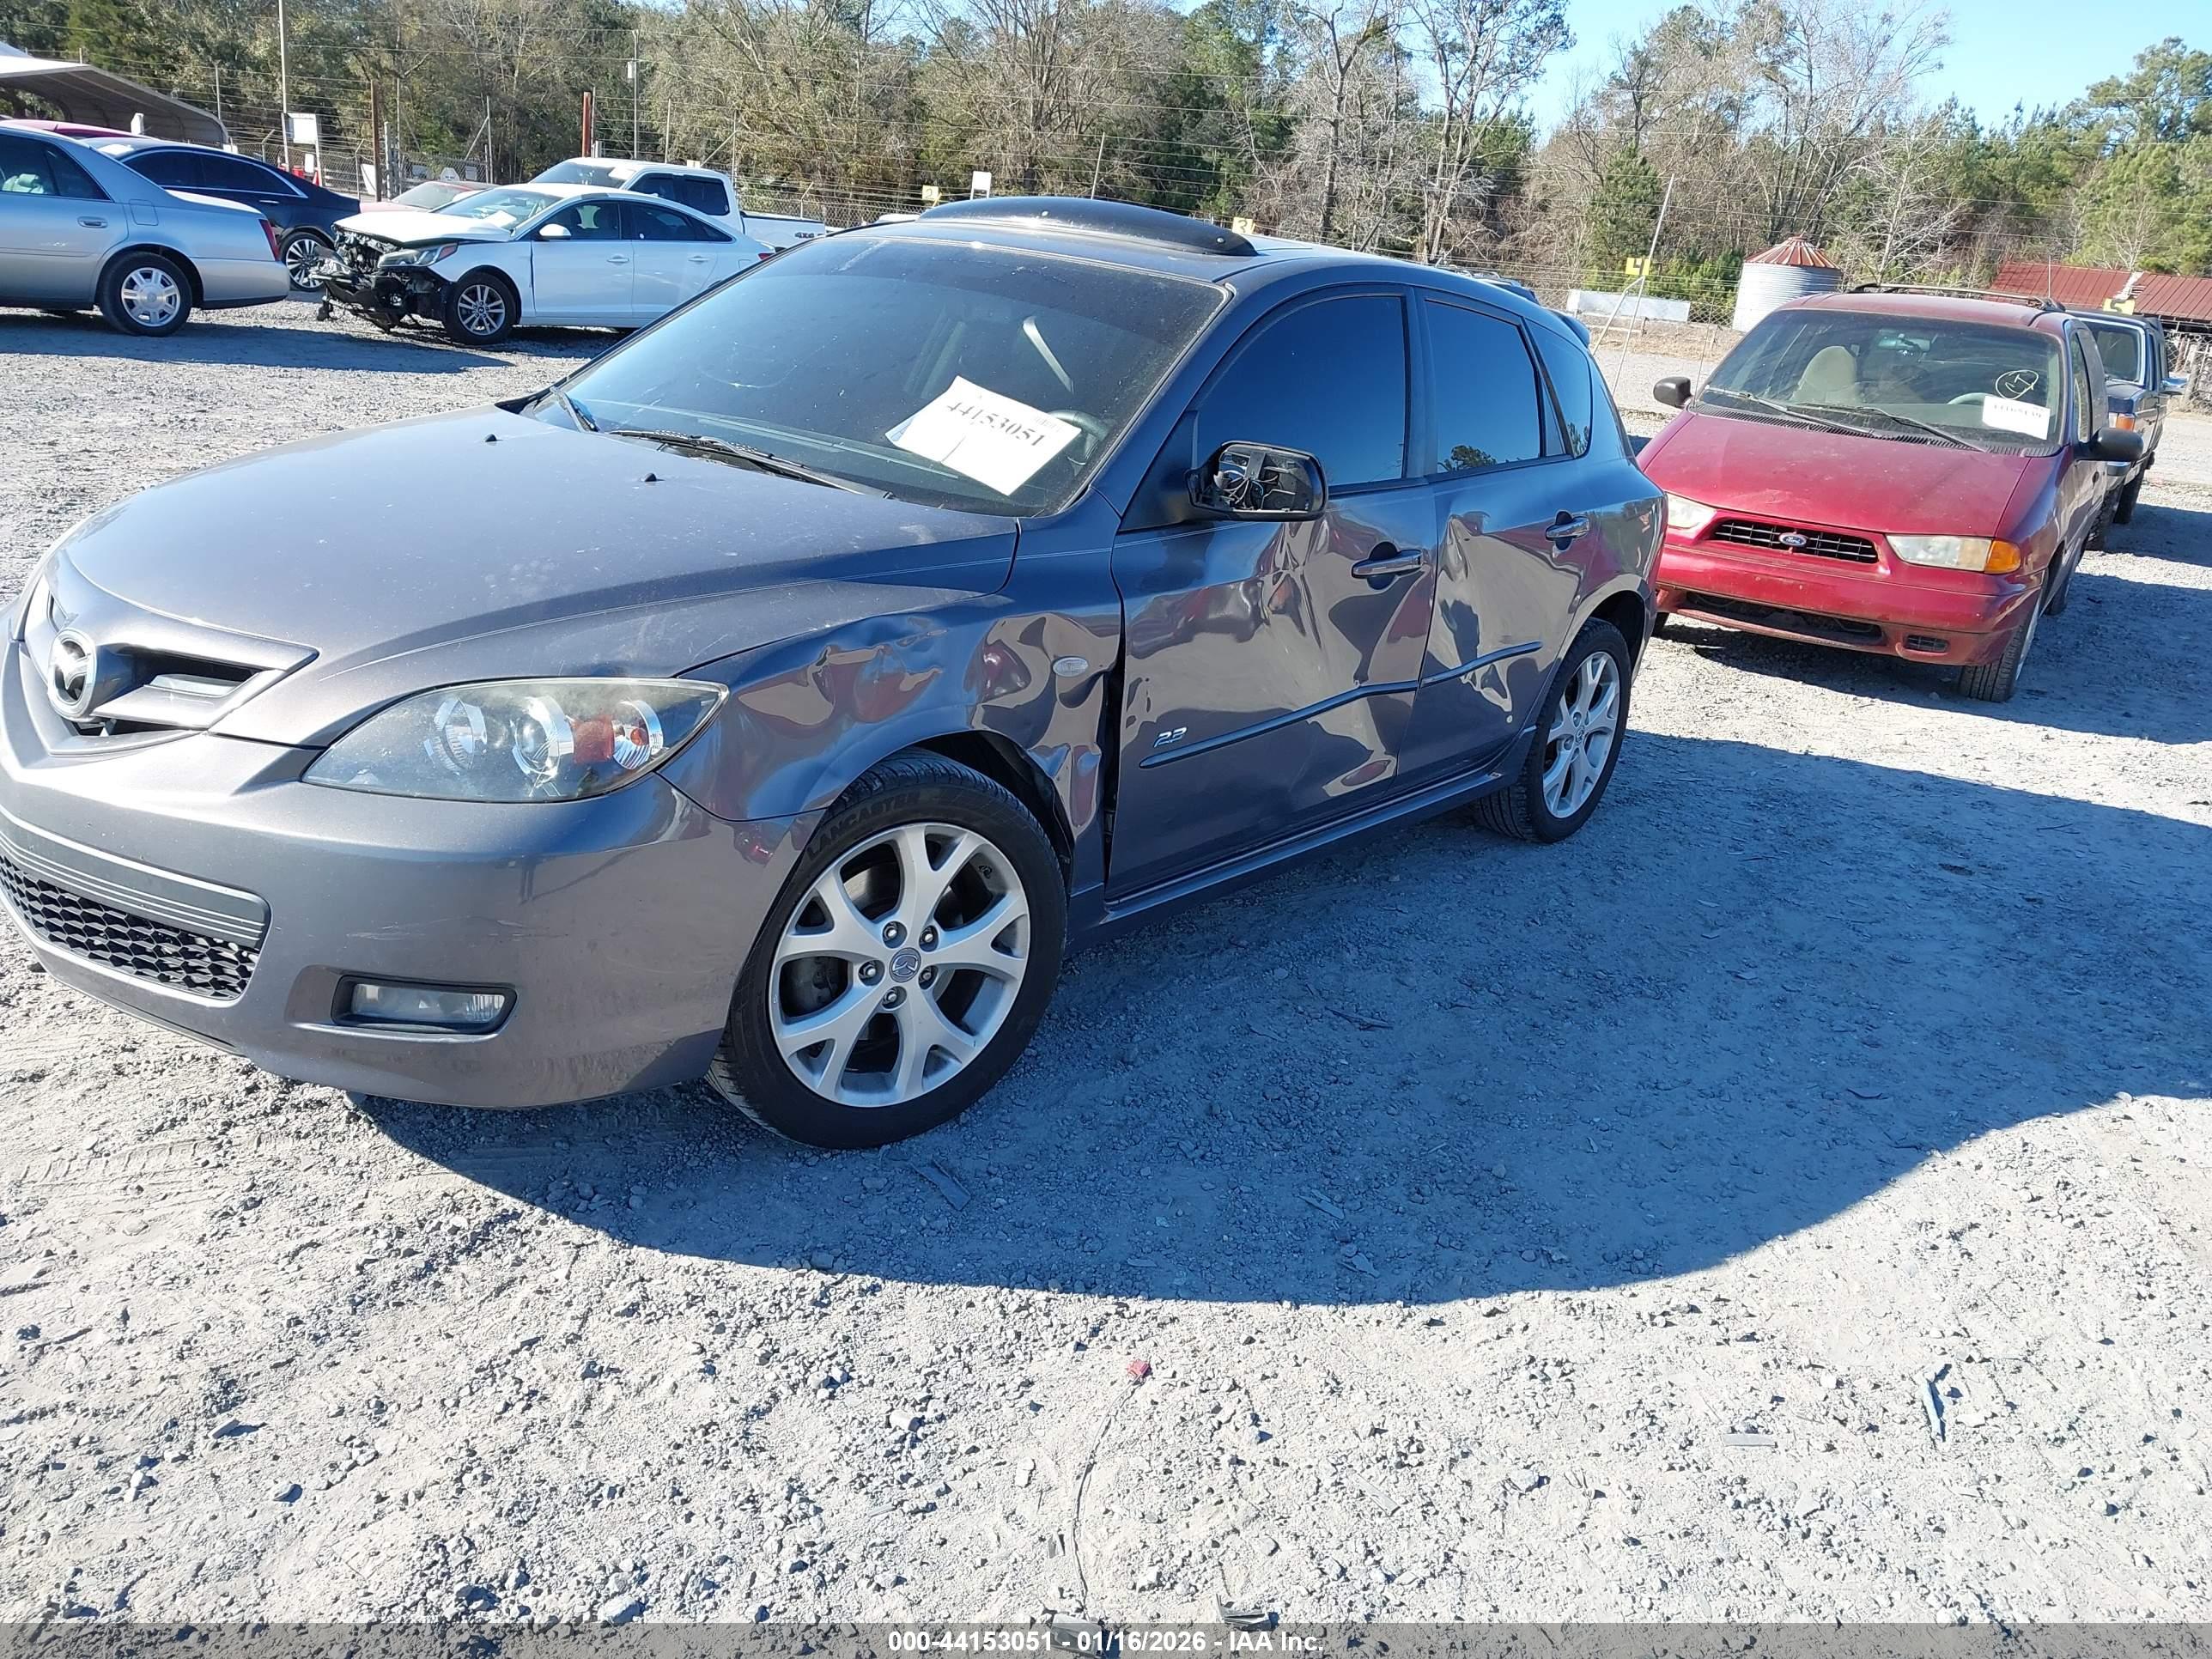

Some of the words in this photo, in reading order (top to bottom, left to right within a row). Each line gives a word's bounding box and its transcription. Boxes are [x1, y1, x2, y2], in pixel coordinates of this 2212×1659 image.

[925, 188, 935, 200] 2
[1237, 219, 1249, 234] 3
[1632, 258, 1645, 275] 4
[2110, 298, 2127, 313] 5
[946, 402, 1045, 446] 44153051
